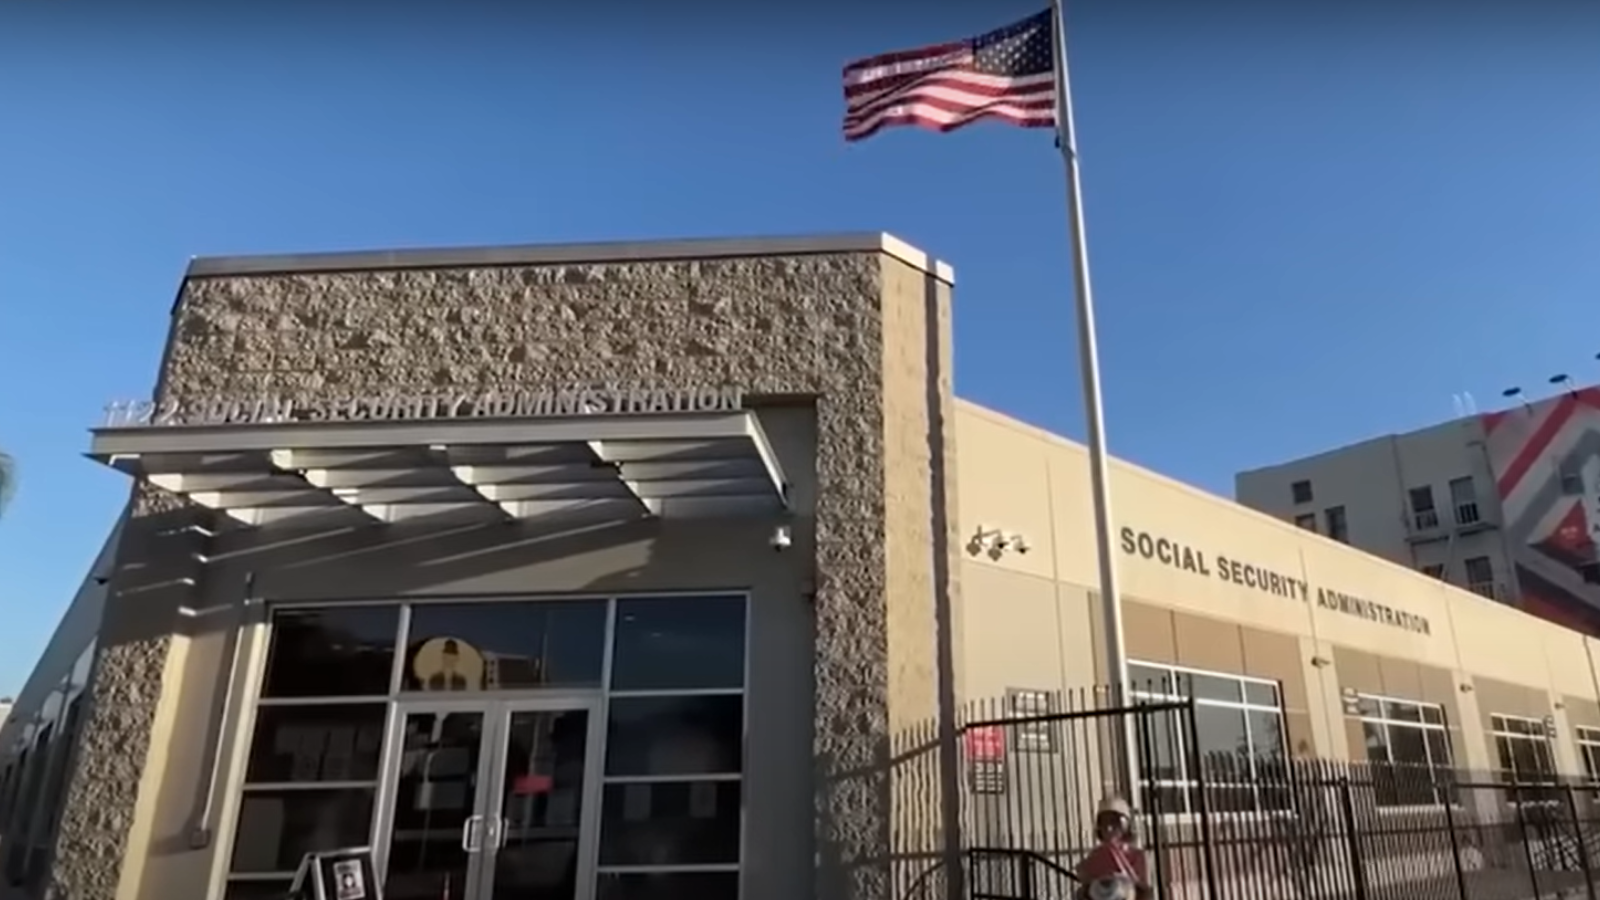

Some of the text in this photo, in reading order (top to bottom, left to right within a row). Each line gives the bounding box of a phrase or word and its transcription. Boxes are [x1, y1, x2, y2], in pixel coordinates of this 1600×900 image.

[310, 393, 466, 421] SECURITY
[471, 384, 745, 418] ADMINISTRATION
[1120, 526, 1432, 636] SOCIAL SECURITY ADMINISTRATION
